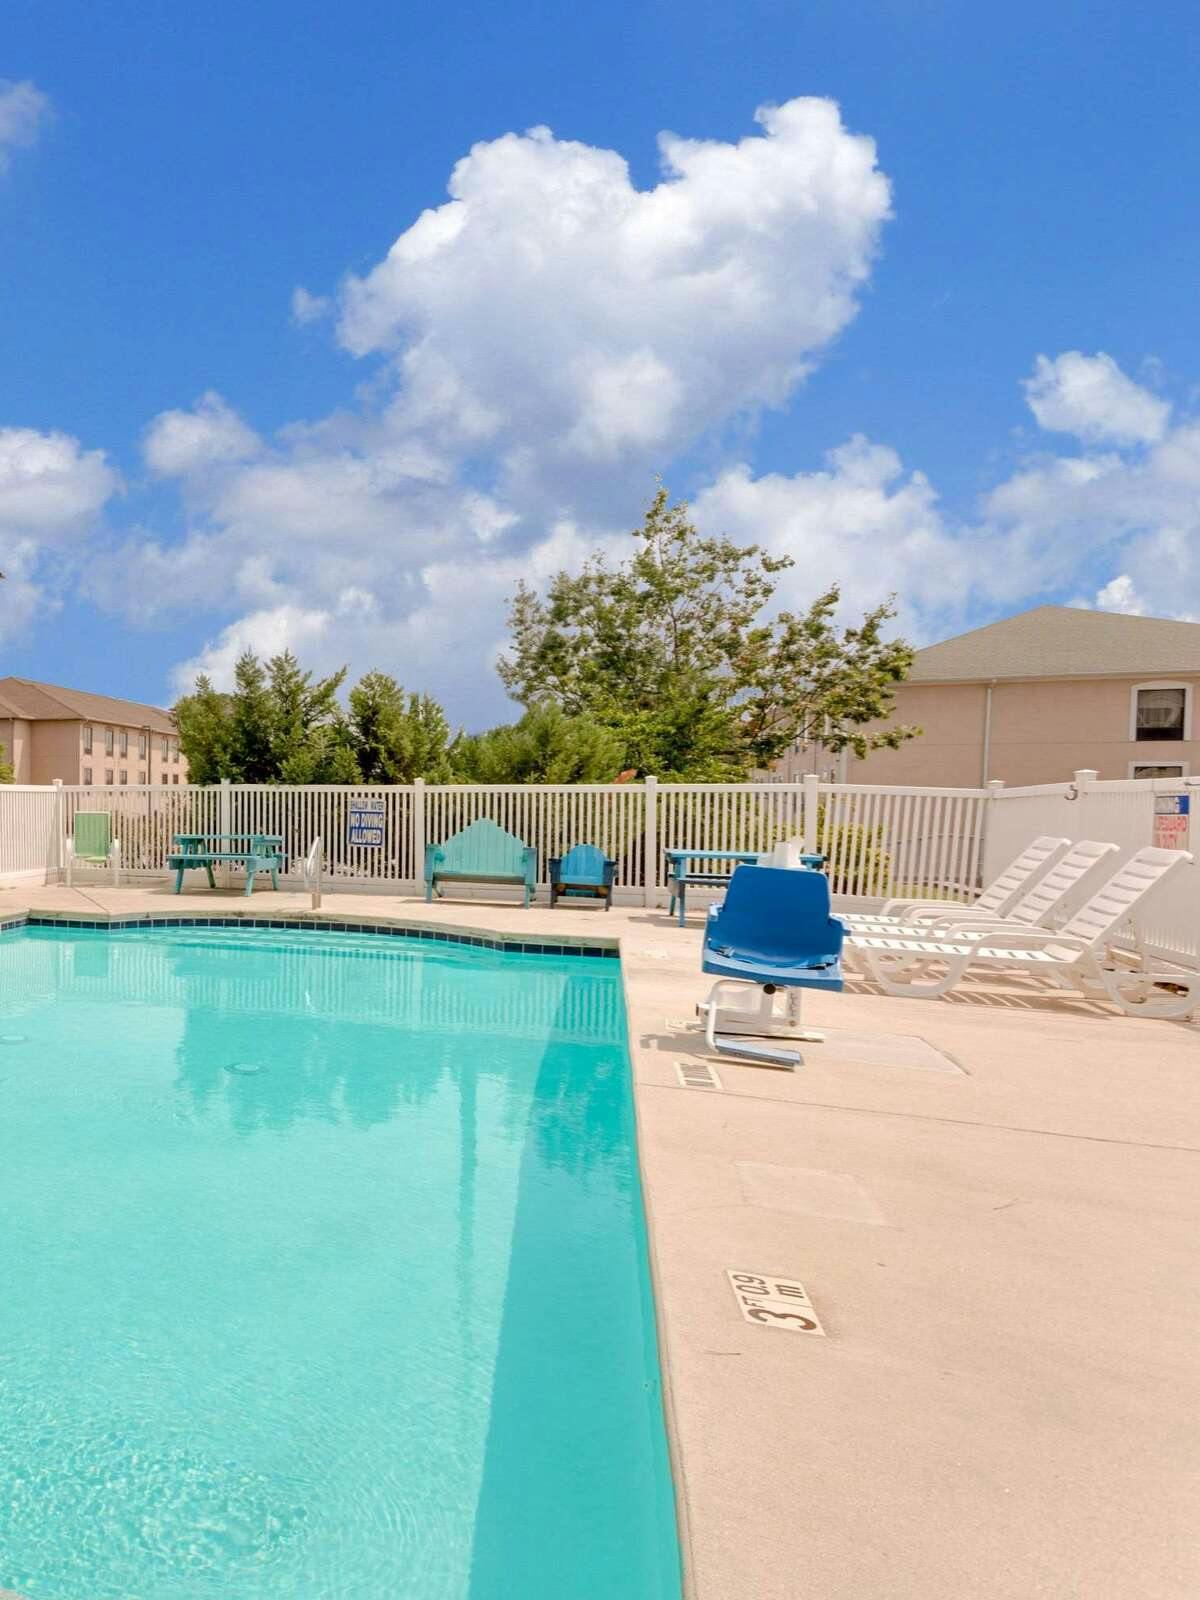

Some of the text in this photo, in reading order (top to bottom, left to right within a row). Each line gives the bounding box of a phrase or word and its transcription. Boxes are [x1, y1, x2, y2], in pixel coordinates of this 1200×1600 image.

[351, 813, 361, 827] NO
[351, 828, 382, 844] ALLOWED
[731, 1274, 771, 1296] 0.9
